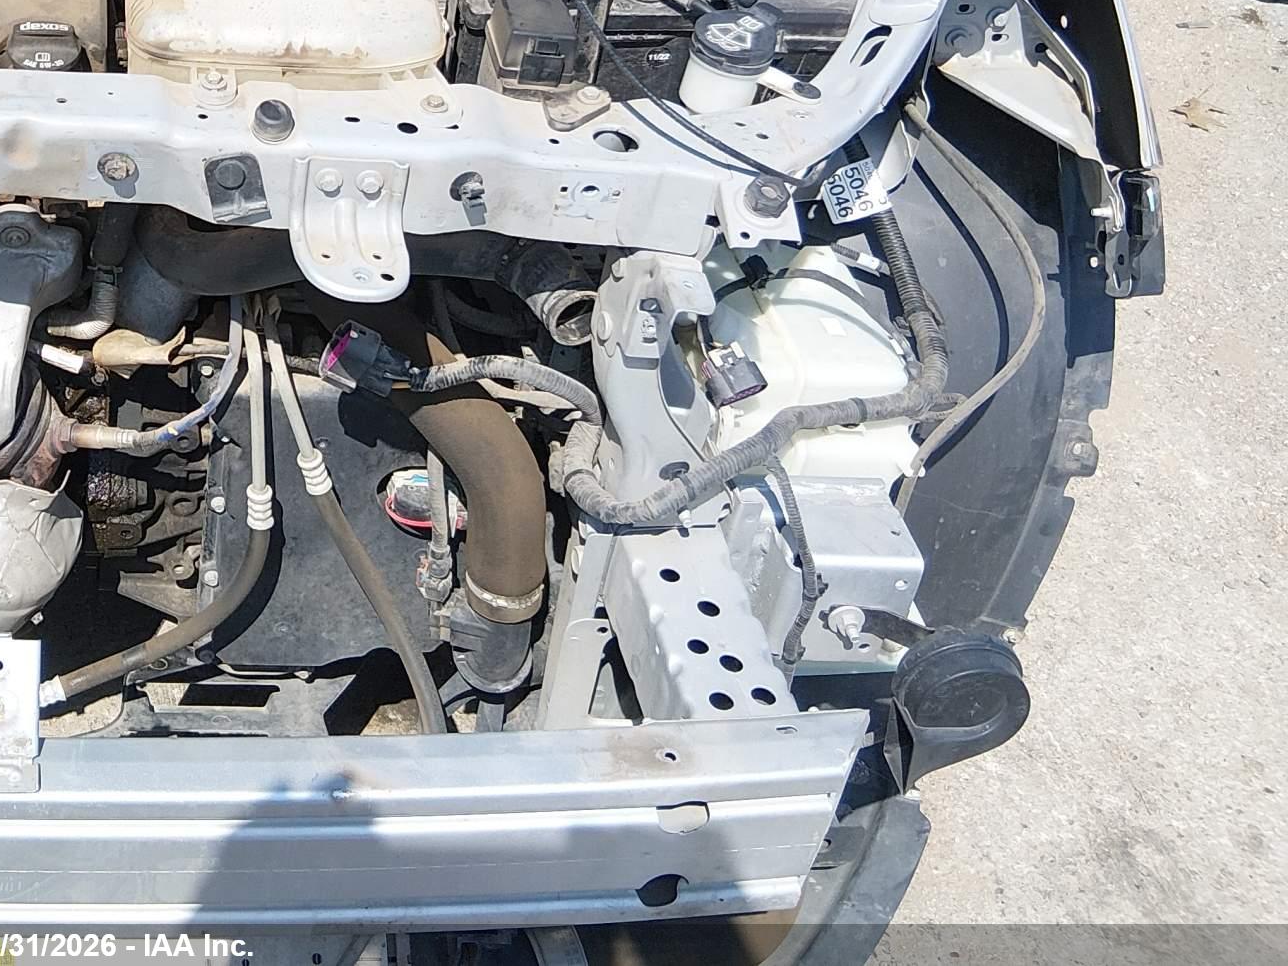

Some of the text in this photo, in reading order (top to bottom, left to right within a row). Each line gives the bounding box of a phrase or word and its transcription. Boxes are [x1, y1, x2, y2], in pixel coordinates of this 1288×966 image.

[19, 21, 69, 31] dexos
[827, 174, 854, 218] 5046
[845, 167, 874, 211] 5046
